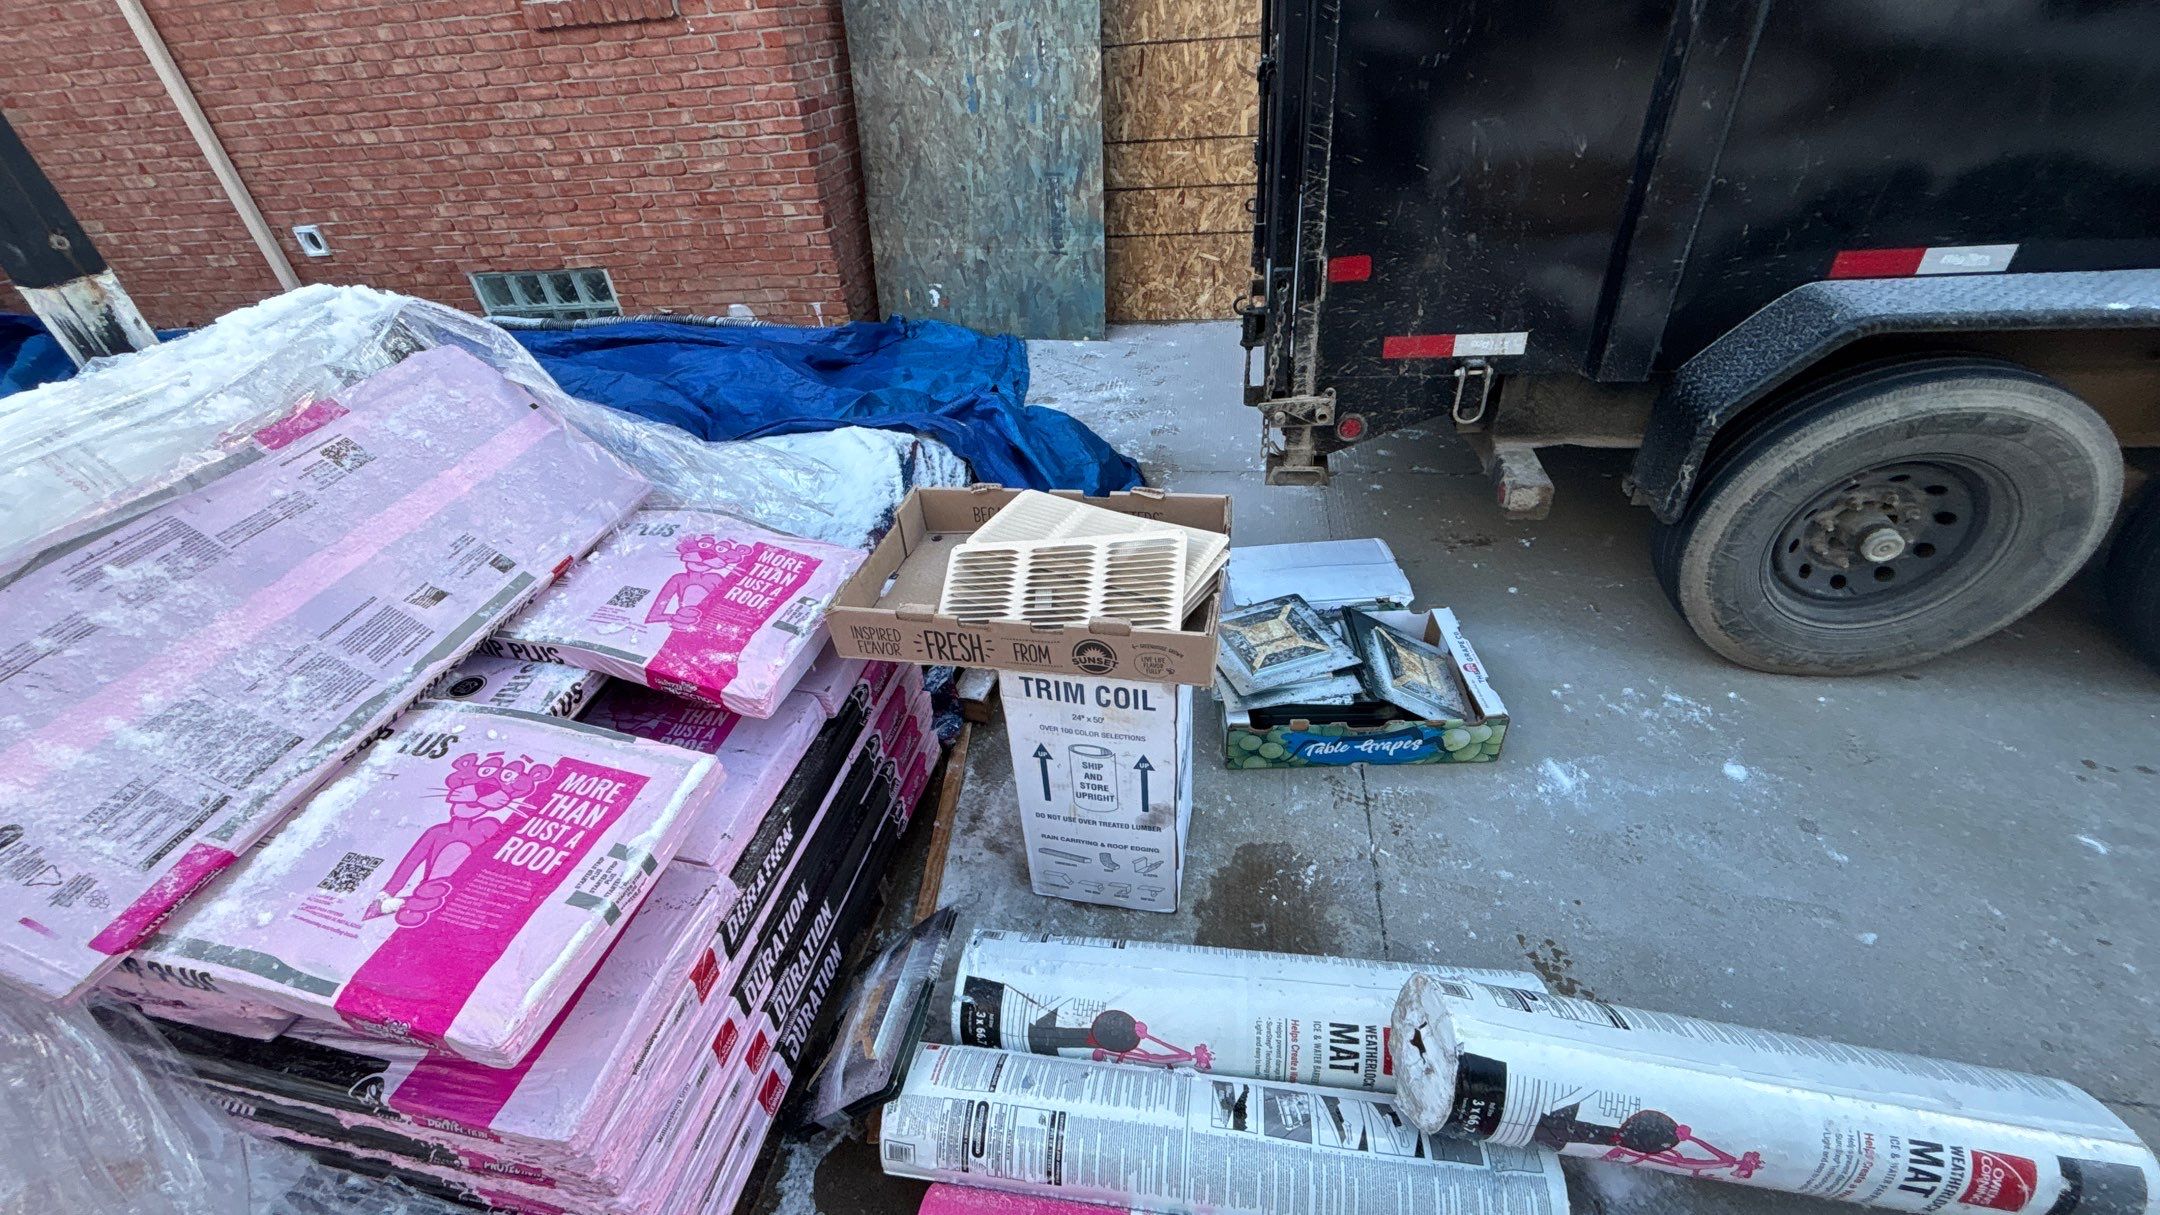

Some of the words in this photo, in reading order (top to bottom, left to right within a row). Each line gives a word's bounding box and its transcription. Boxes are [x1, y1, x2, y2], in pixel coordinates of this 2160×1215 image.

[758, 550, 806, 574] MORE
[736, 575, 773, 594] JUST
[770, 586, 784, 597] A
[749, 563, 798, 587] THAN
[724, 586, 775, 610] ROOF
[850, 625, 902, 642] INSPIRED
[507, 642, 565, 665] PLUS
[857, 640, 902, 656] FLAVOR
[923, 630, 986, 663] FRESH
[1013, 642, 1052, 664] FROM
[1457, 640, 1473, 662] GRAPE
[1072, 656, 1119, 669] SUNSET
[1018, 676, 1086, 705] TRIM
[1095, 685, 1157, 711] COIL
[679, 708, 730, 727] THAN
[667, 722, 705, 738] JUST
[703, 727, 717, 740] A
[1040, 724, 1059, 732] OVER
[1061, 727, 1073, 735] 100
[1074, 729, 1100, 738] COLOR
[1101, 732, 1147, 742] SELECTIONS
[1304, 741, 1351, 757] Table
[1354, 739, 1424, 756] Grapes
[1082, 761, 1103, 770] SHIP
[1084, 772, 1103, 781] AND
[557, 771, 627, 804] MORE
[1075, 792, 1115, 802] UPRIGHT
[1080, 782, 1109, 792] STORE
[539, 792, 609, 829] THAN
[516, 816, 571, 844] JUST
[564, 830, 586, 850] A
[1047, 813, 1061, 821] NOT
[1063, 815, 1077, 823] USE
[1080, 818, 1097, 826] OVER
[1099, 820, 1130, 829] TREATED
[1131, 823, 1162, 832] LUMBER
[1041, 833, 1059, 841] RAIN
[1060, 836, 1099, 847] CARRYING
[1130, 845, 1160, 854] EDGING
[492, 836, 570, 875] ROOF
[726, 818, 794, 943] DURATION
[744, 882, 810, 1008] DURATION
[774, 896, 834, 1022] DURATION
[785, 937, 843, 1061] DURATION
[1290, 1019, 1299, 1042] Helps
[1313, 1020, 1322, 1033] ICE
[1290, 1044, 1299, 1066] Create
[1313, 1043, 1322, 1064] WATER
[1329, 1022, 1360, 1074] MAT
[1363, 1025, 1378, 1089] WEATHERLOCK
[657, 1099, 683, 1143] Williamsburg
[679, 1082, 691, 1098] Gray
[1889, 1135, 1901, 1150] ICE
[1898, 1138, 1945, 1198] MAT
[1988, 1168, 2005, 1205] OWENS
